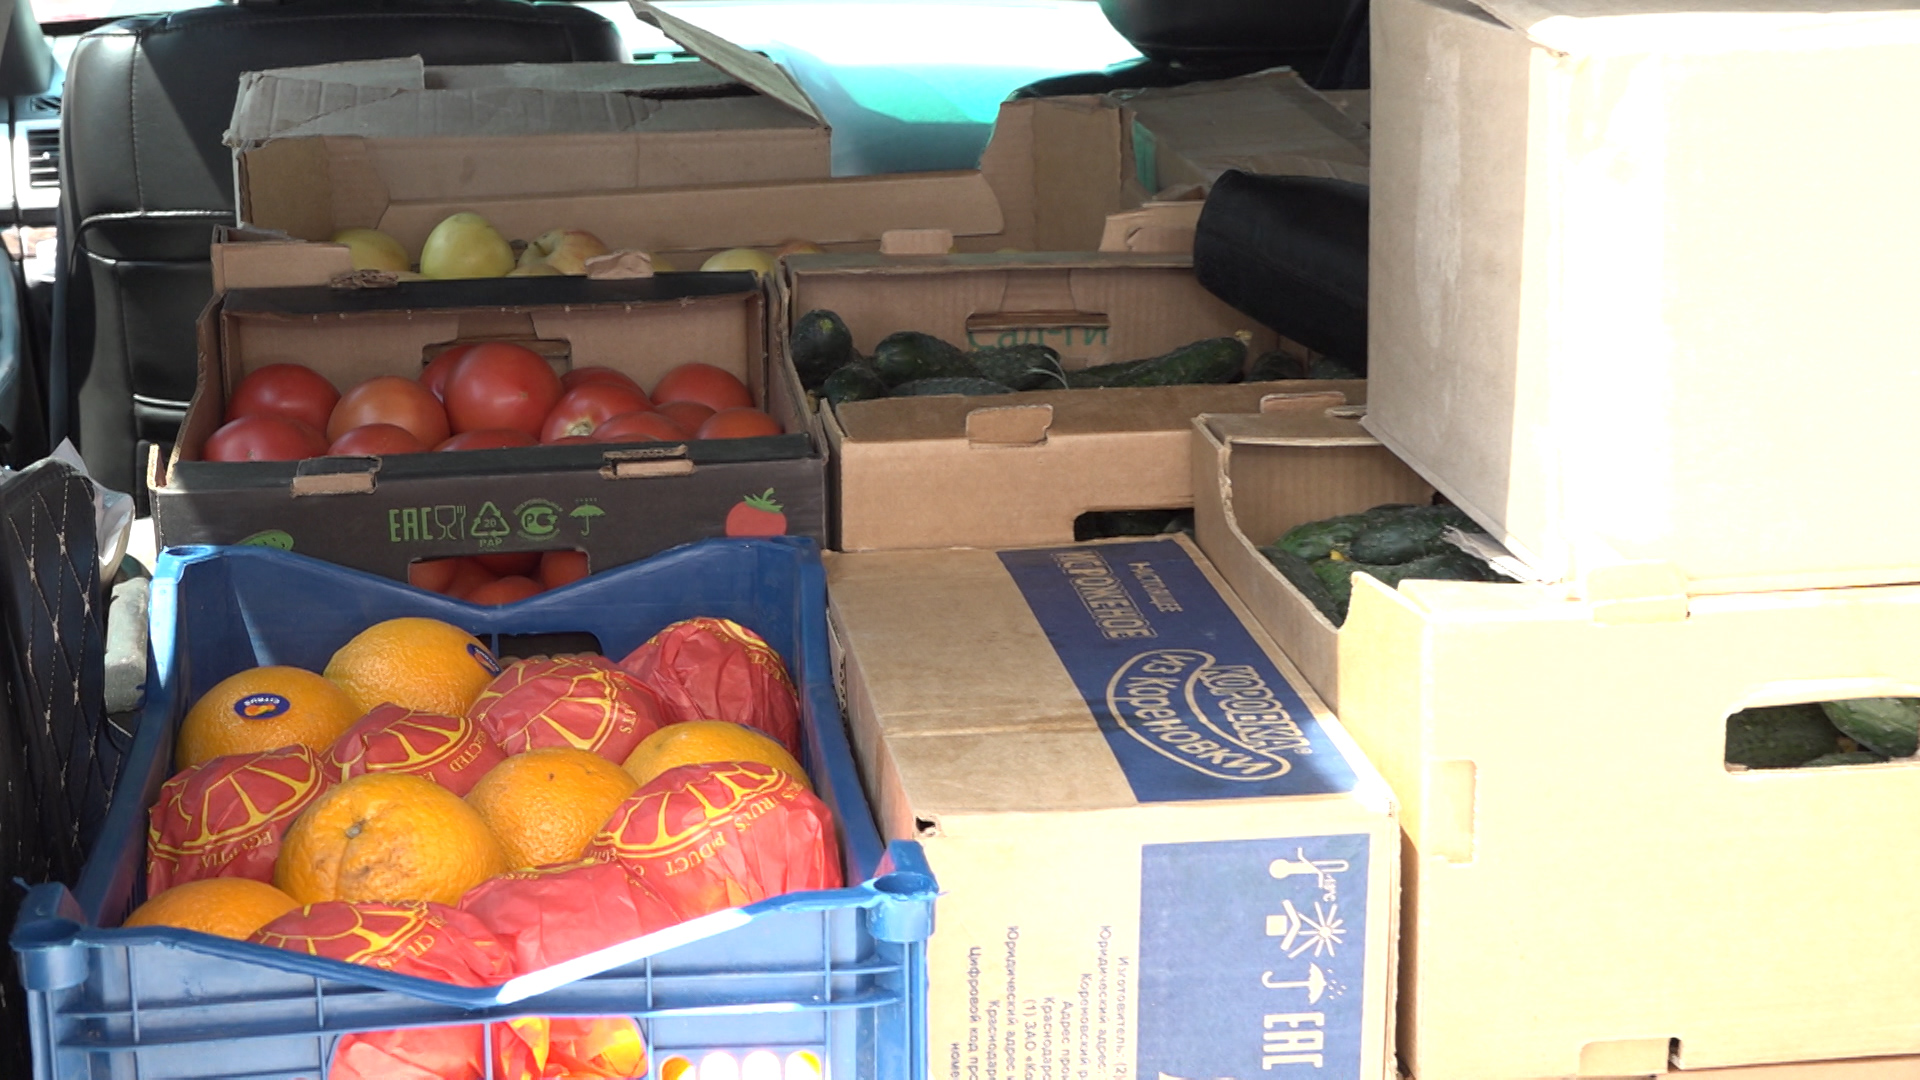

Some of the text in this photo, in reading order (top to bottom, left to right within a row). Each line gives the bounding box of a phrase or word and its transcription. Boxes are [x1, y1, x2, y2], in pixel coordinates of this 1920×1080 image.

[966, 946, 983, 1023] Цифровой
[1004, 925, 1019, 1026] Юридический
[1097, 925, 1112, 1024] Юридический
[1022, 999, 1037, 1017] (1)
[1058, 1001, 1074, 1044] Адрес
[966, 1027, 979, 1053] код
[1003, 1030, 1015, 1072] адрес
